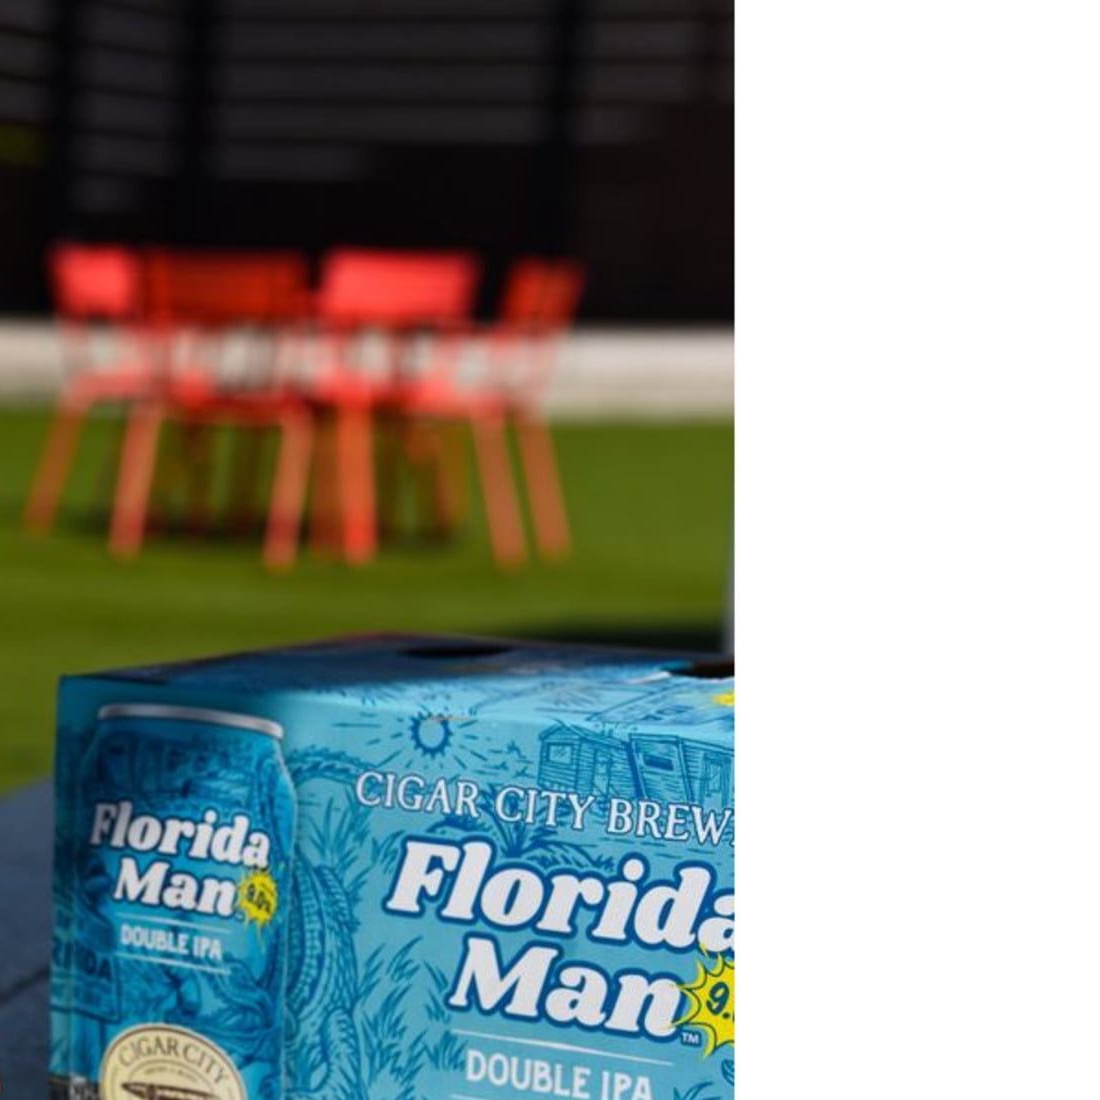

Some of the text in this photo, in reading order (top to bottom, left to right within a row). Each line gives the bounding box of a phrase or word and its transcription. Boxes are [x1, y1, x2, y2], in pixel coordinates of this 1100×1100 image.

[89, 800, 270, 868] Florida
[356, 771, 734, 848] CIGAR CITY BREW
[112, 857, 237, 917] Man
[119, 923, 223, 960] DOUBLE IPA
[447, 935, 682, 1038] Man
[706, 982, 734, 1024] 9.
[117, 1035, 182, 1067] CIGAR
[183, 1043, 230, 1084] CITY
[465, 1049, 591, 1100] DOUBLE
